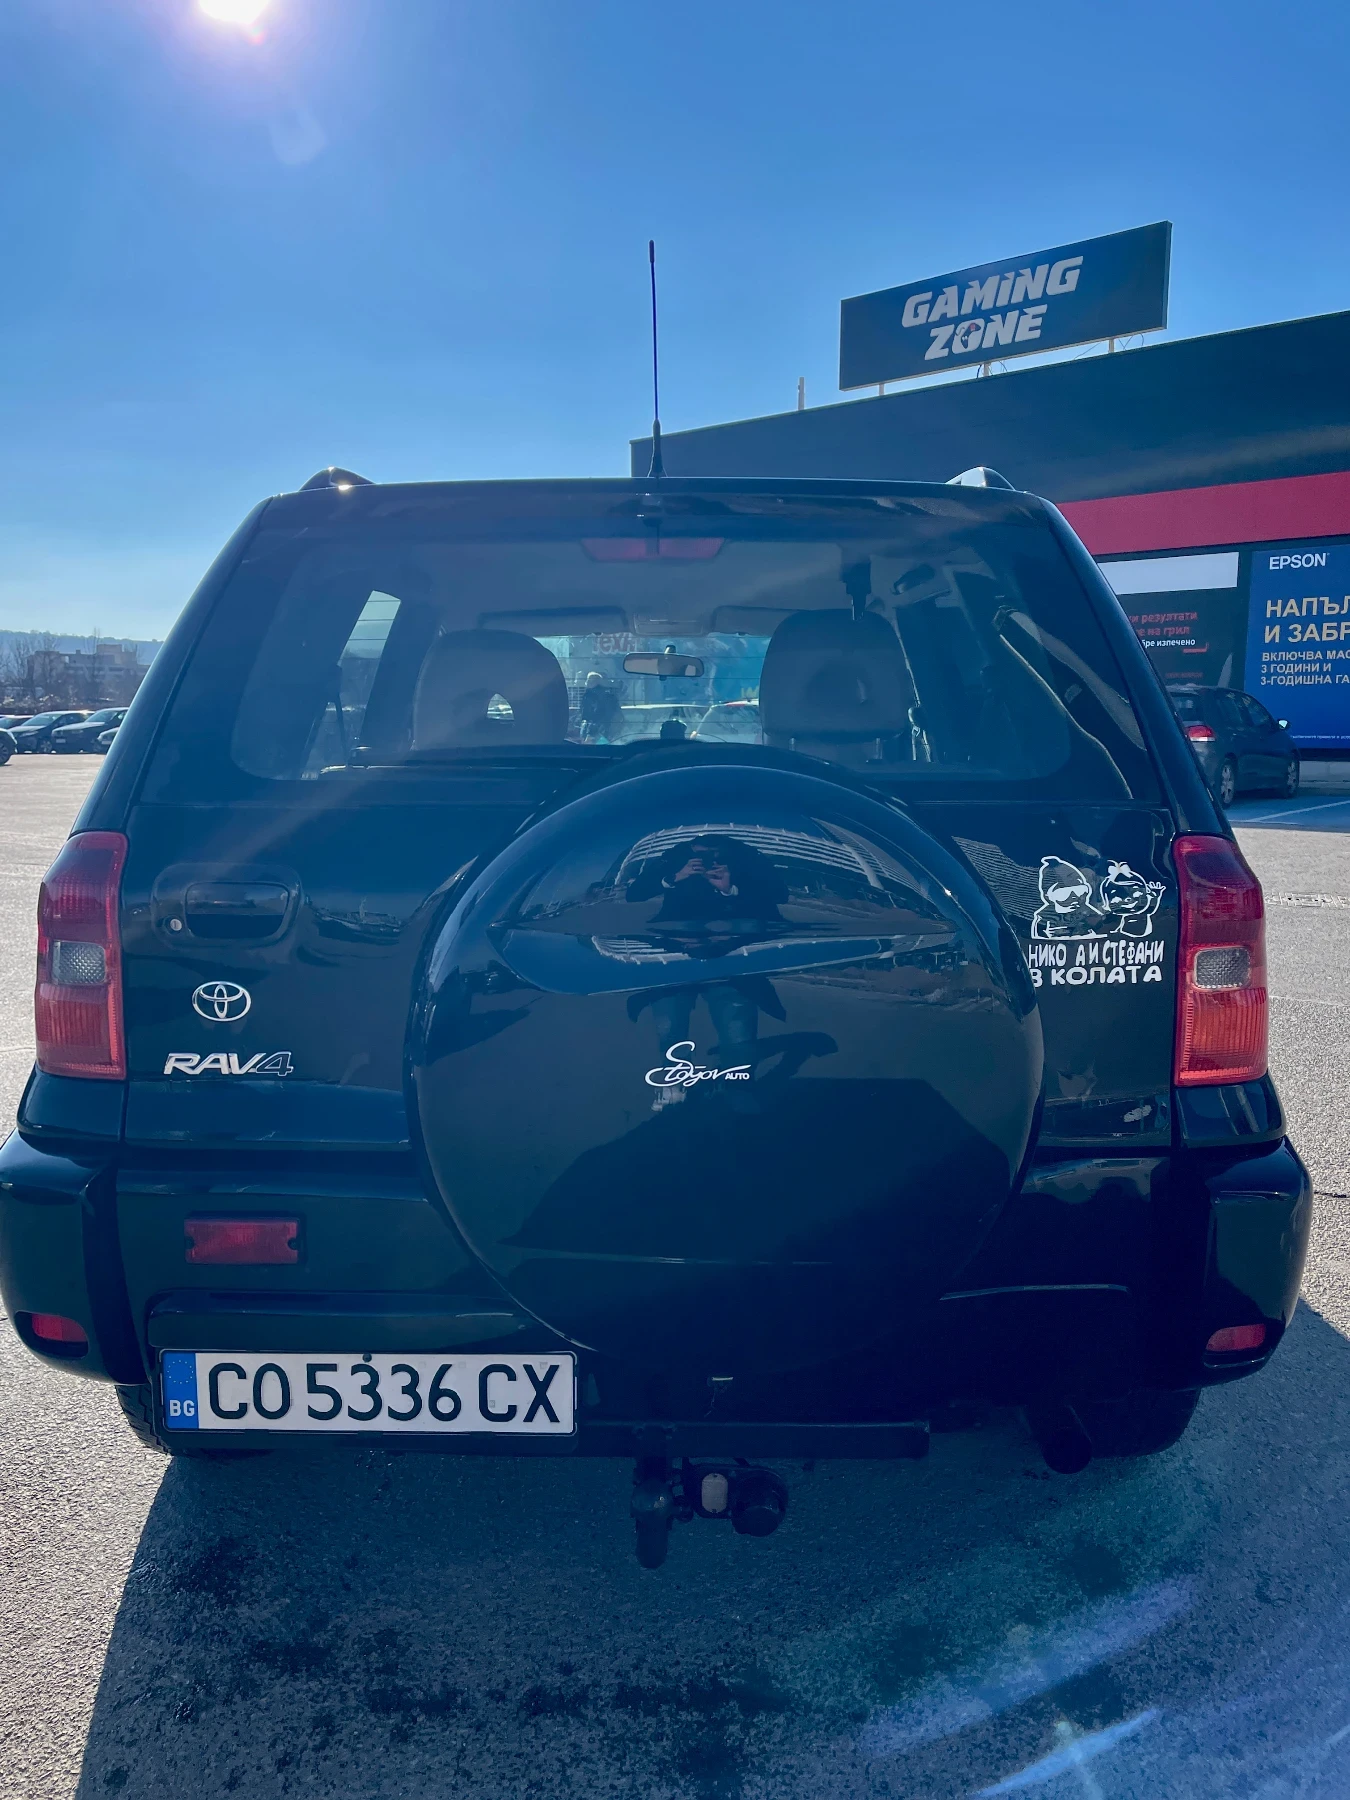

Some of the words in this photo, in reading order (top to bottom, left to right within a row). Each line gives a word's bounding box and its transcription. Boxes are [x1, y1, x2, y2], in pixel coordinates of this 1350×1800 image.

[902, 255, 1083, 328] GAMING
[924, 304, 1048, 360] ZONE
[1269, 553, 1327, 570] EPSON
[1156, 638, 1196, 647] изпечено
[1264, 625, 1281, 644] И
[1262, 651, 1323, 661] ВКЛЮЧВА
[1261, 664, 1267, 674] 3
[1270, 663, 1320, 674] ГОДИНИ
[1323, 662, 1332, 672] И
[1260, 674, 1332, 687] 3-ГОДИШНА
[1028, 943, 1067, 968] НИКО
[1102, 939, 1165, 966] СТЕФАНИ
[1051, 965, 1162, 986] КОЛАТА
[163, 1051, 294, 1077] RAV4
[724, 1072, 750, 1080] AUTO
[208, 1362, 292, 1420] CO
[306, 1362, 462, 1422] 5336
[478, 1363, 560, 1423] CX
[169, 1399, 195, 1417] BG
